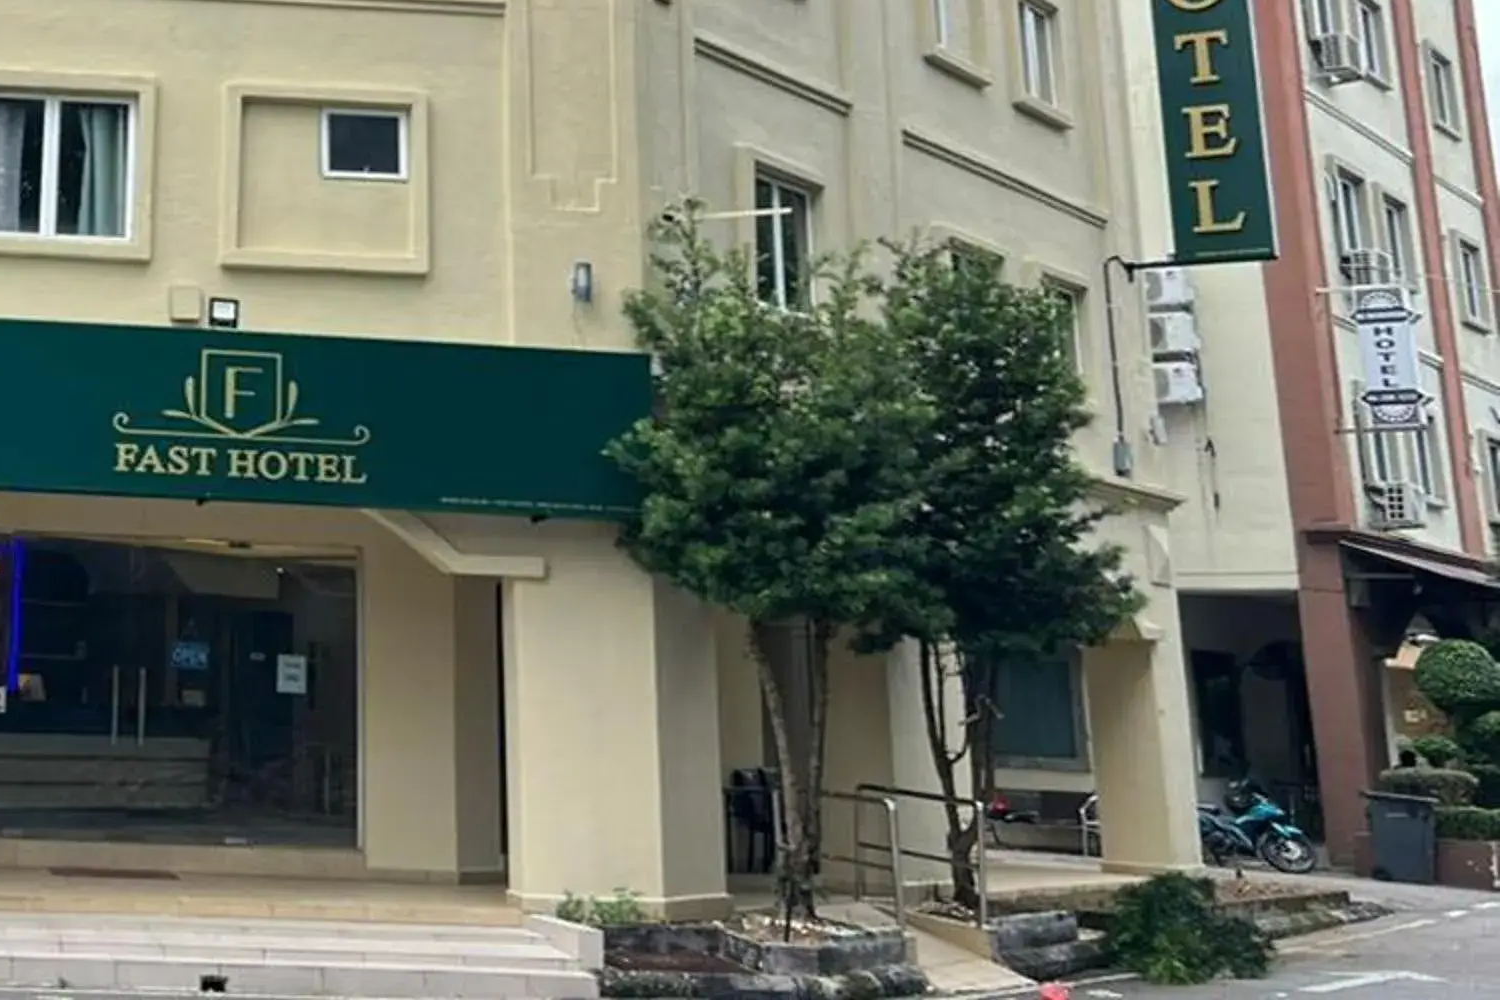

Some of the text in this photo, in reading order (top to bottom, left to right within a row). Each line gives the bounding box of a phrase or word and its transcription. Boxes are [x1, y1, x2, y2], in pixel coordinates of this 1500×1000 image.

[1372, 325, 1399, 388] HOTEL
[225, 366, 263, 419] F
[113, 442, 368, 484] FAST HOTEL
